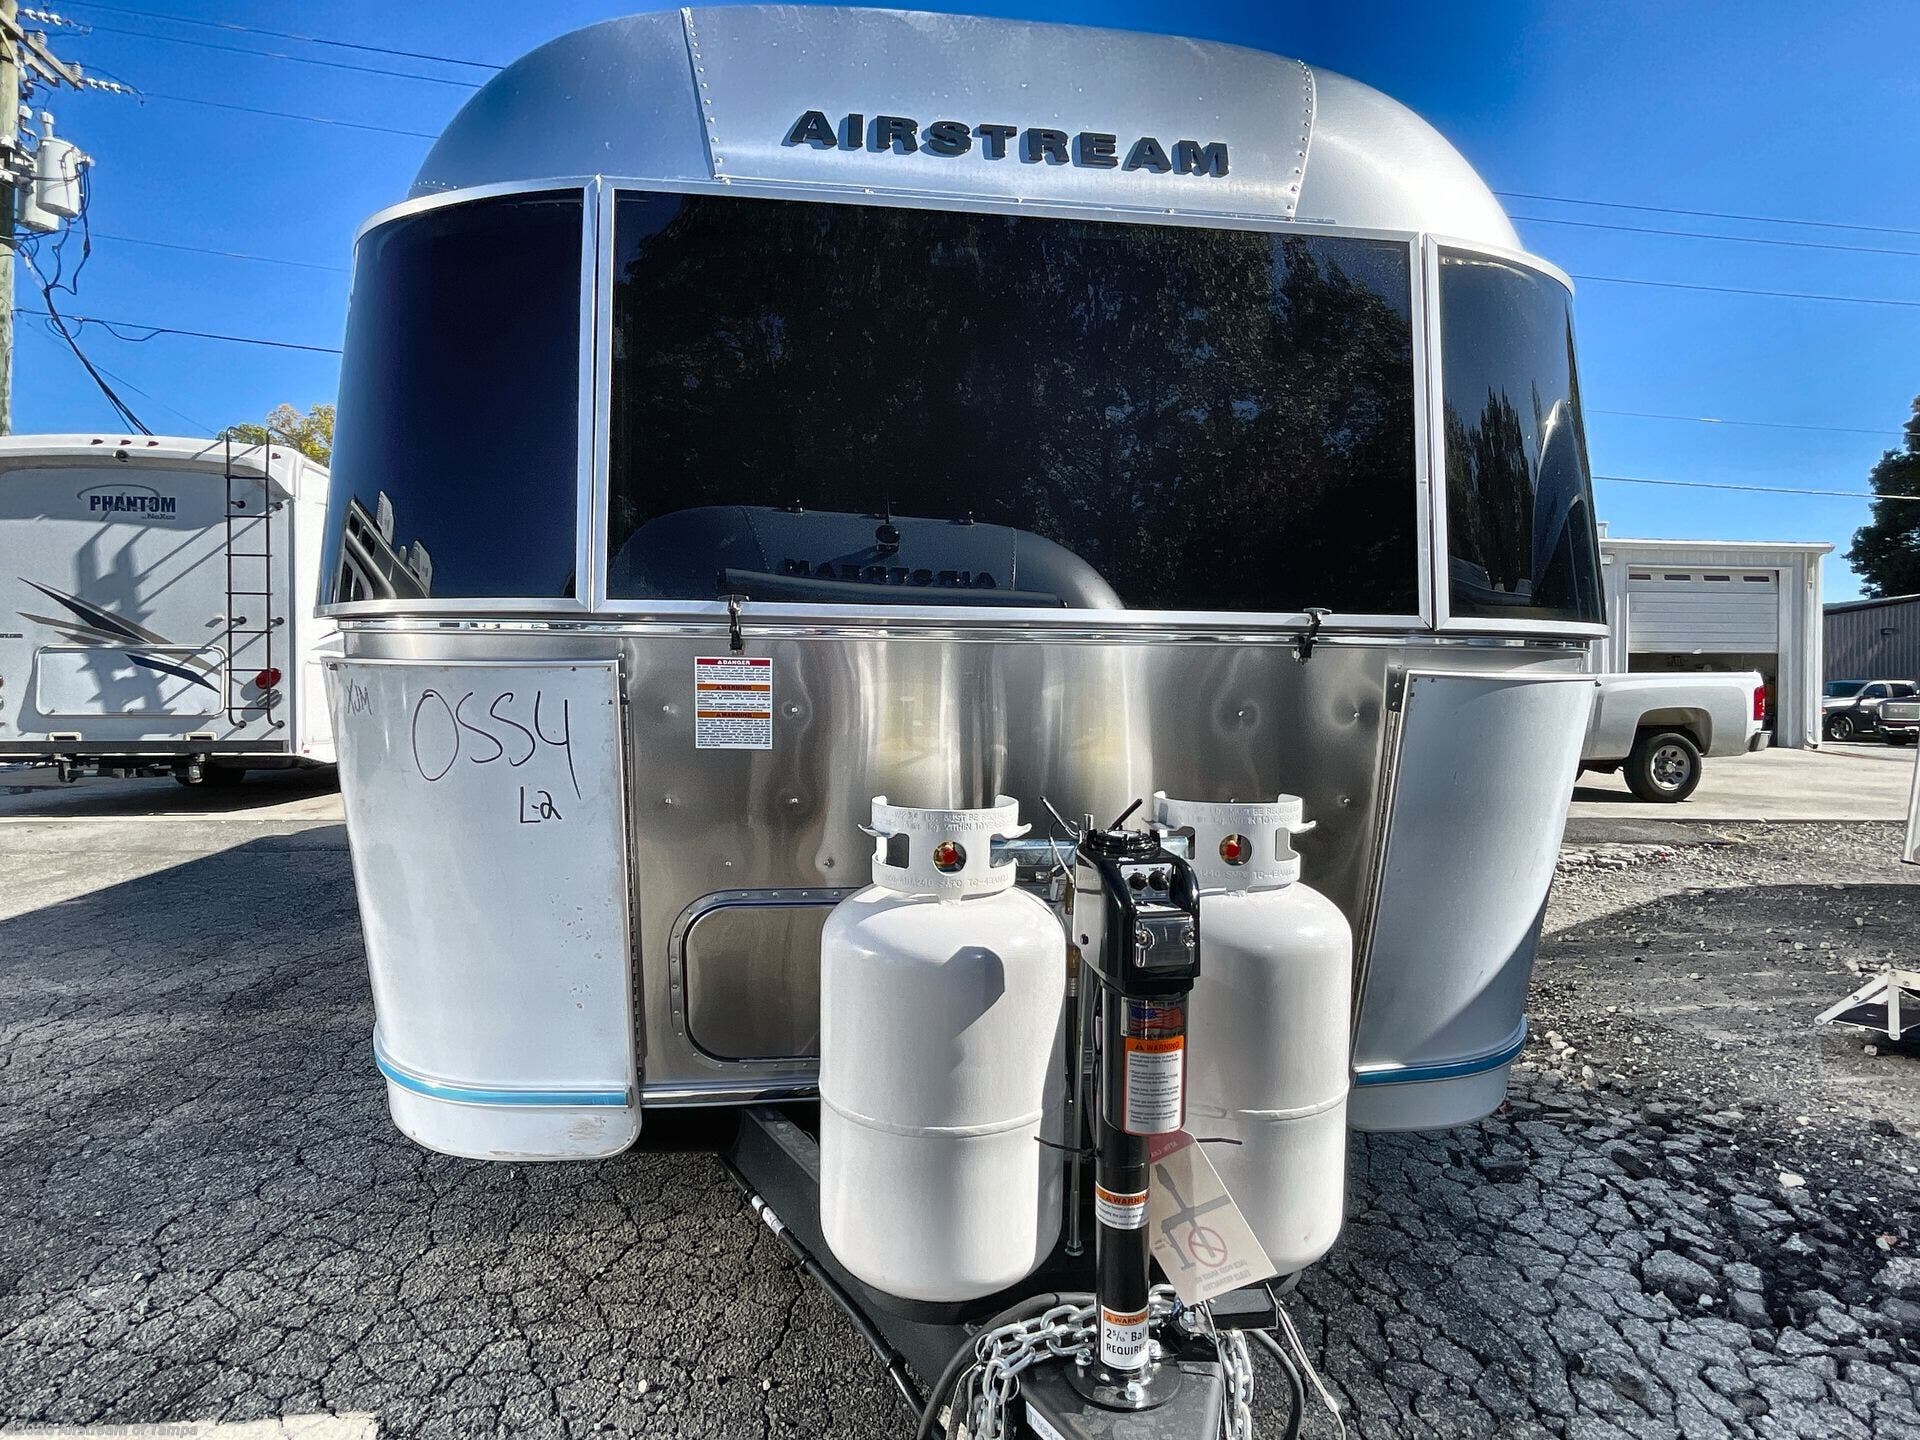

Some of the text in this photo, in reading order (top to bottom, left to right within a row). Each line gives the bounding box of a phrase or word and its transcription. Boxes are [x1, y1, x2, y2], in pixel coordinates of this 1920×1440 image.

[782, 110, 1230, 178] AIRSTREAM
[89, 495, 176, 513] PHANTOM
[1146, 1041, 1180, 1051] WARNING
[1131, 1327, 1147, 1342] Ball
